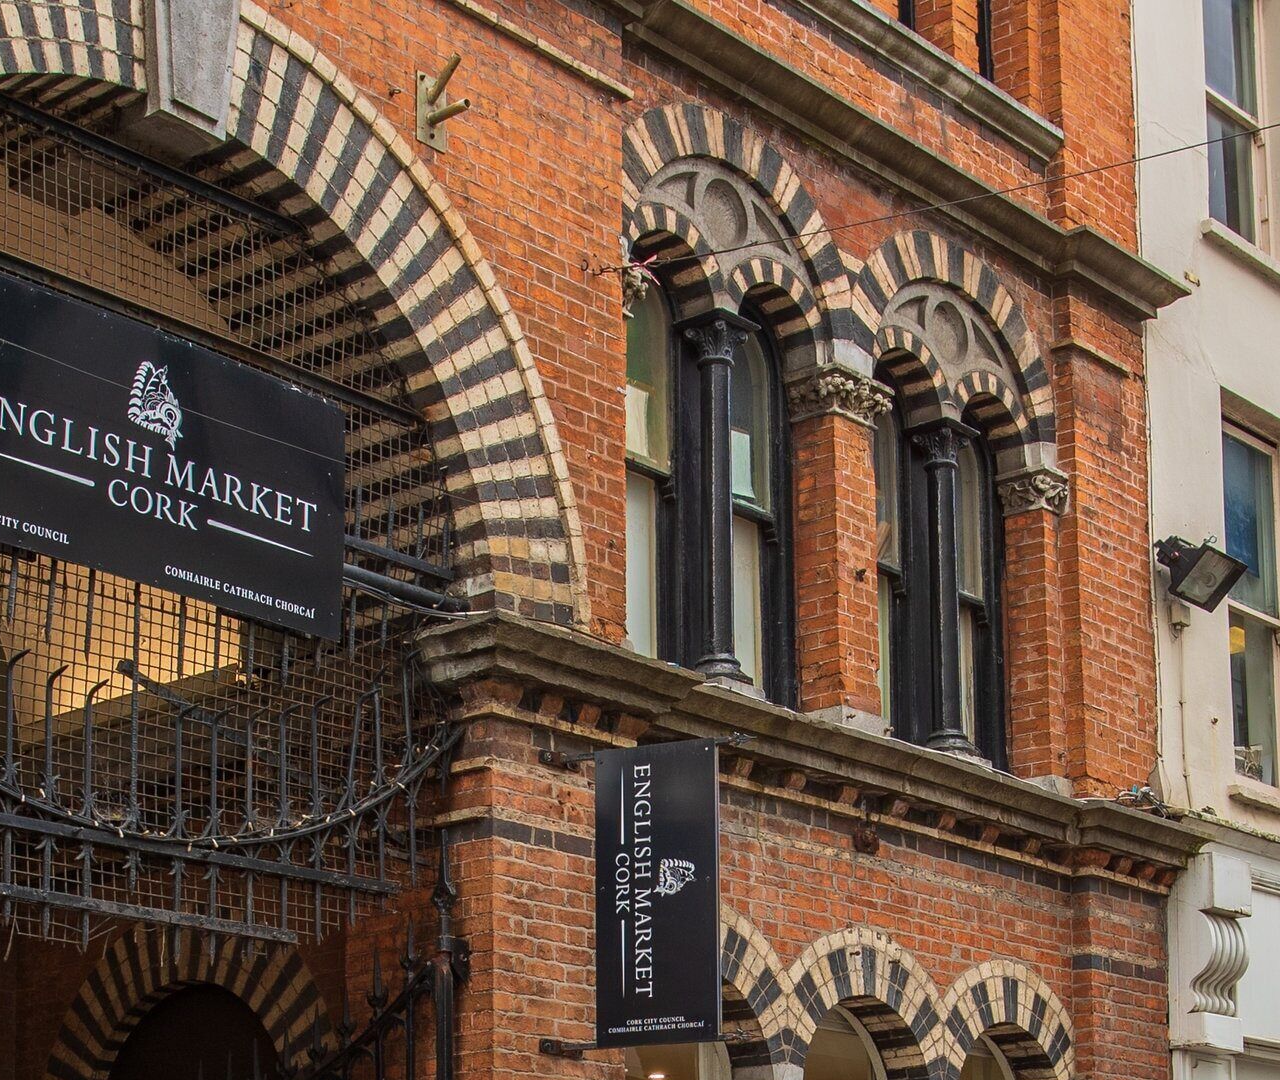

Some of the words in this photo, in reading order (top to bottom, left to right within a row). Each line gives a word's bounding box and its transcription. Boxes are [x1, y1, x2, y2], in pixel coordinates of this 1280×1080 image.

[107, 478, 199, 531] CORK
[164, 453, 318, 532] MARKET
[22, 522, 70, 545] COUNCIL
[164, 564, 221, 590] COMHAIRLE
[223, 582, 273, 607] CATHRACH
[275, 598, 316, 619] CHORCAÍ
[632, 763, 652, 879] ENGLISH
[615, 852, 631, 914] CORK
[634, 888, 653, 998] MARKET
[607, 1025, 642, 1034] COMHAIRLE
[643, 1022, 676, 1032] CATHRACH
[626, 1018, 643, 1026] CORK
[643, 1017, 658, 1025] CITY
[659, 1015, 686, 1023] COUNCIL
